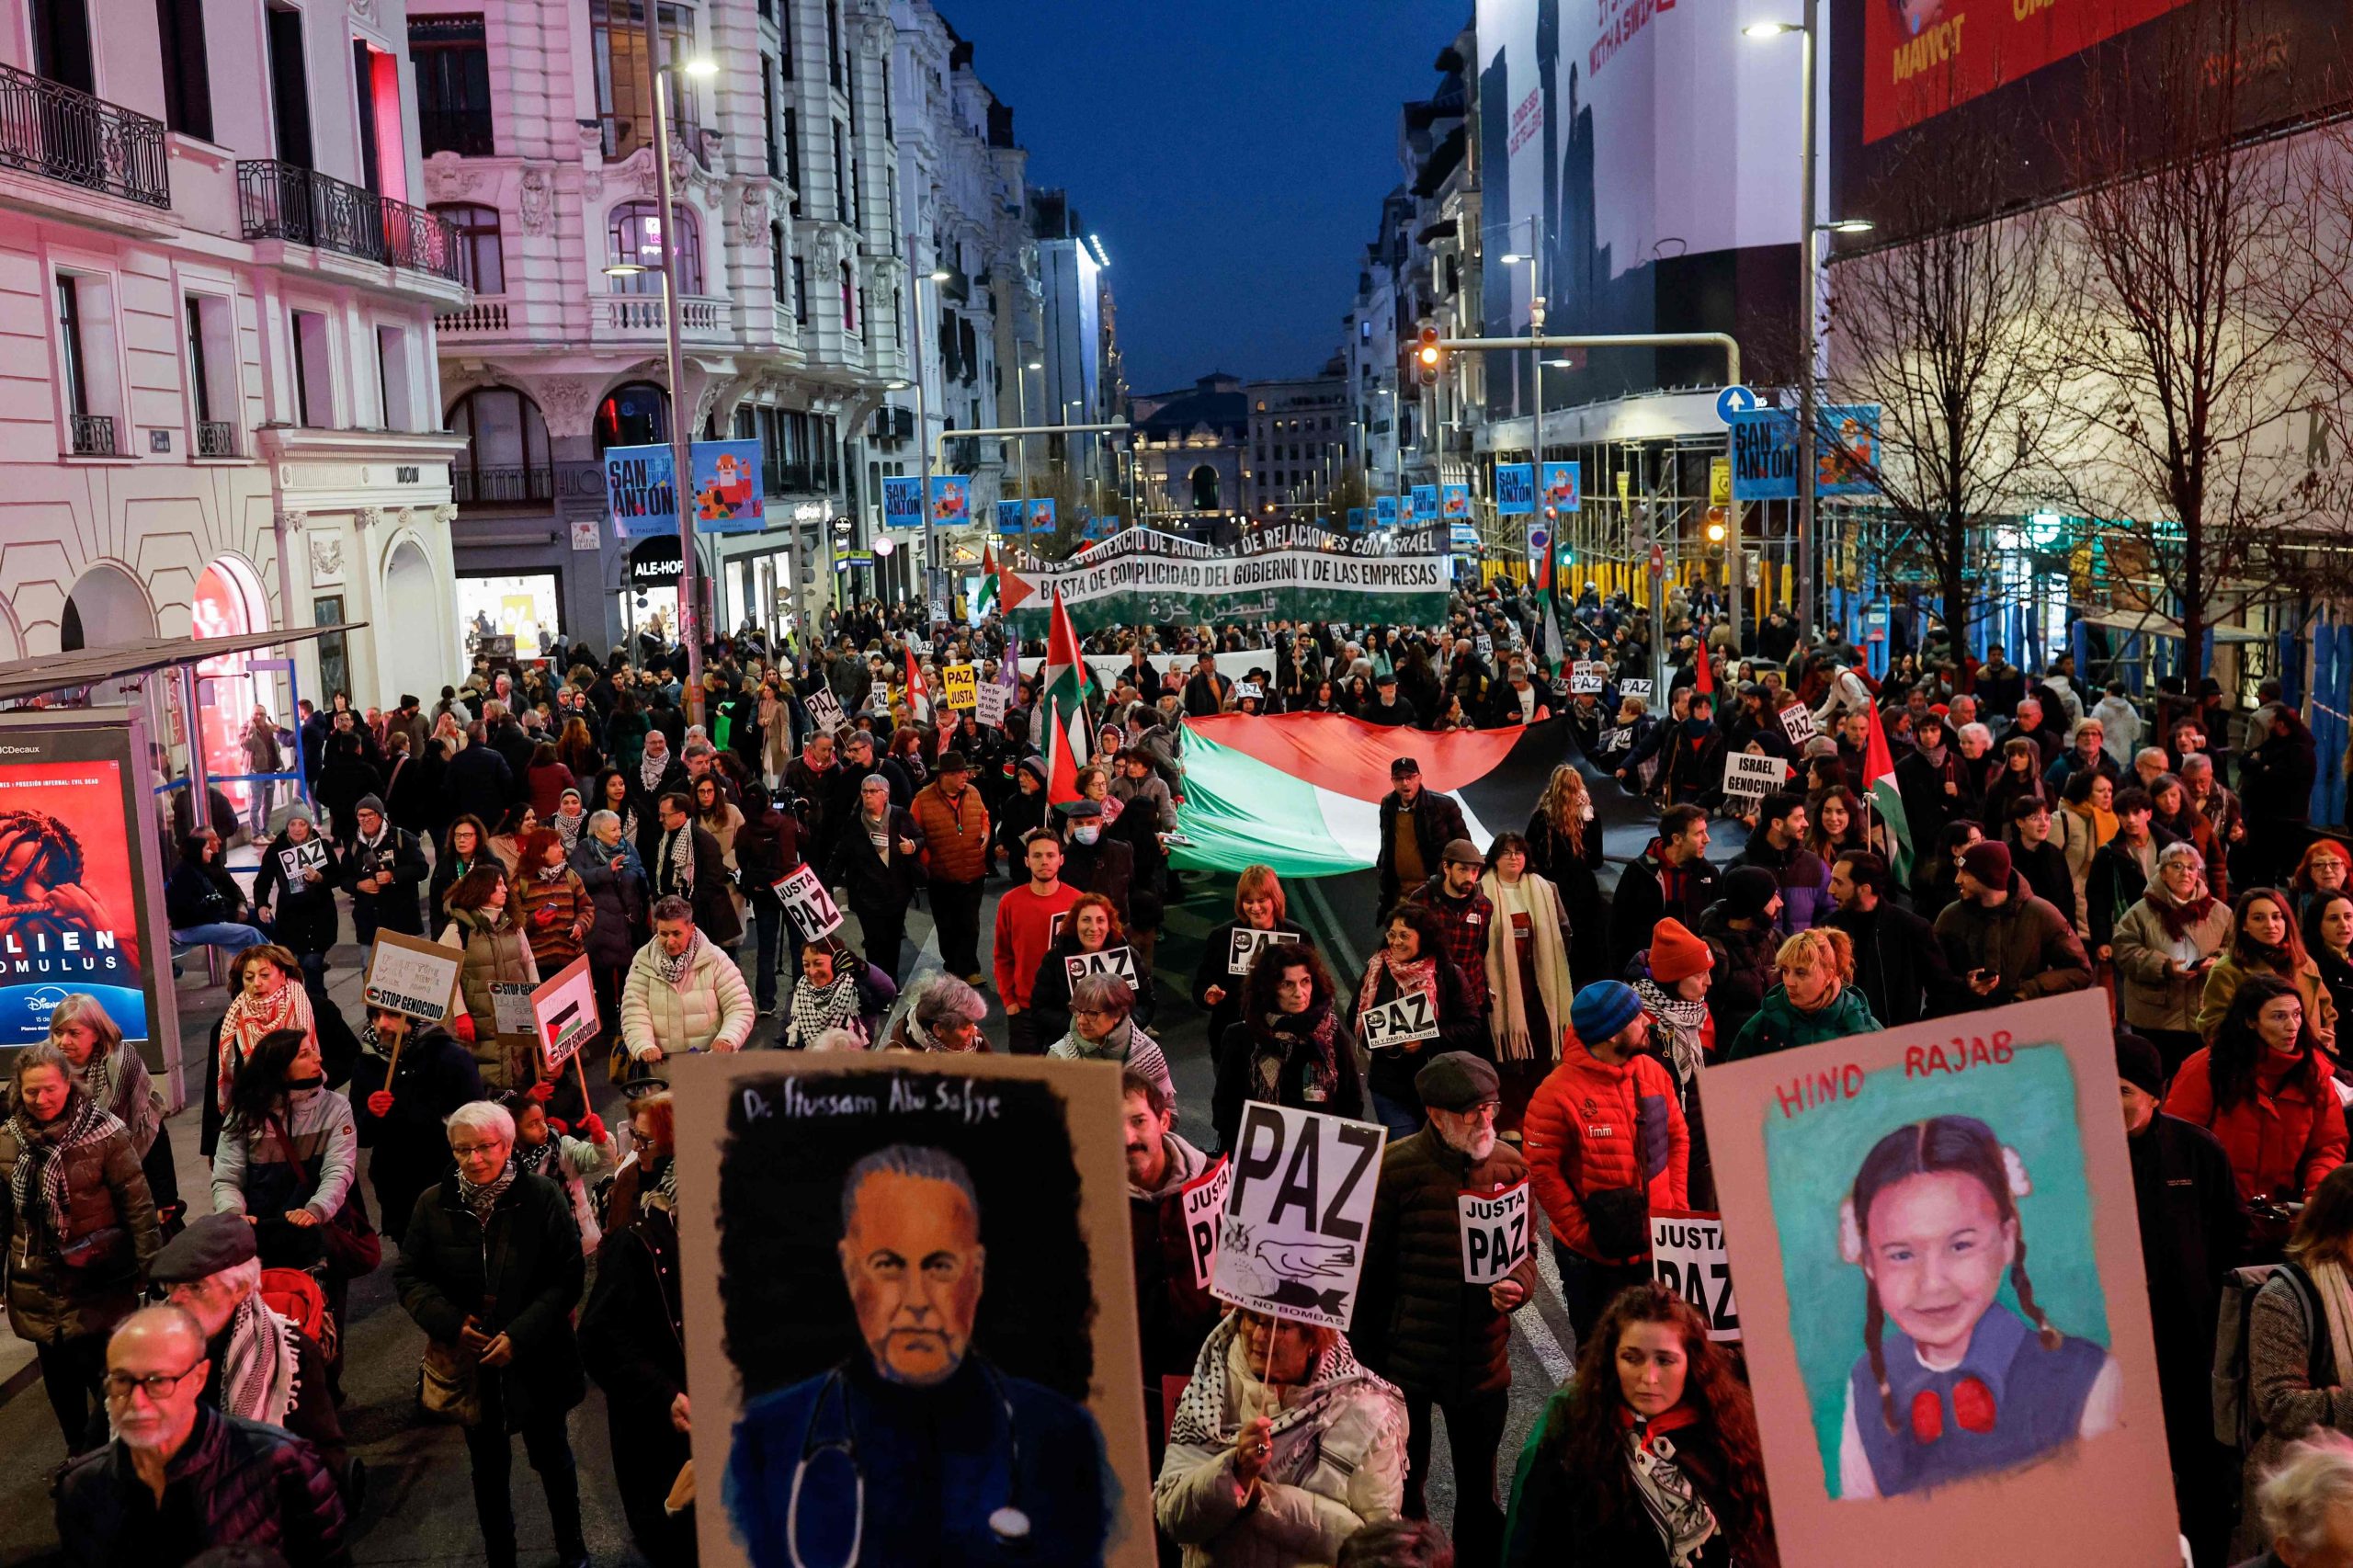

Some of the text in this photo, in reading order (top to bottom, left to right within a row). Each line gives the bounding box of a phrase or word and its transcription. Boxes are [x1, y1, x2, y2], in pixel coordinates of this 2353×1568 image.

[1736, 422, 1772, 452] SAN
[396, 466, 419, 484] WOW
[609, 460, 647, 489] SAN
[1736, 445, 1793, 480] ANTÓN
[885, 483, 906, 500] SAN
[1498, 472, 1519, 486] SAN
[613, 483, 675, 517] ANTÓN
[1017, 549, 1040, 572] FIN
[1044, 561, 1073, 574] DEL
[1075, 529, 1145, 566] COMERCIO
[1149, 533, 1168, 553] DE
[1171, 539, 1225, 559] ARMAS
[1229, 544, 1237, 557] Y
[1241, 532, 1263, 554] DE
[1263, 523, 1349, 551] RELACIONES
[1352, 538, 1382, 556] CON
[1386, 529, 1437, 553] ISRAEL
[634, 560, 683, 577] ALE-HOP
[1040, 557, 1438, 600] BASTA DE COMPLICIDAD DEL GOBIERNO Y DE LAS EMPRESAS
[931, 600, 943, 613] PAZ
[1200, 590, 1276, 622] فلسطين
[916, 642, 934, 654] PAZ
[1478, 642, 1492, 653] PAZ
[948, 670, 972, 685] PAZ
[1236, 682, 1261, 695] PAZ
[1572, 676, 1601, 689] PAZ
[1620, 679, 1652, 693] PAZ
[806, 690, 838, 718] PAZ
[873, 691, 888, 706] PAZ
[949, 689, 974, 705] JUSTA
[1783, 705, 1804, 721] JUSTA
[1786, 715, 1814, 741] PAZ
[1738, 757, 1776, 777] ISRAEL,
[279, 840, 326, 873] PAZ
[779, 872, 815, 901] JUSTA
[788, 887, 839, 938] PAZ
[6, 930, 115, 954] LIEN
[0, 955, 117, 974] OMULUS
[503, 983, 519, 995] STOP
[381, 989, 444, 1020] STOP GENOCIDIO
[1365, 993, 1436, 1040] PAZ
[557, 1018, 597, 1059] STOP GENOCIDIO
[1414, 1030, 1438, 1039] TIERRA
[1775, 1030, 2015, 1119] HIND RAJAB
[743, 1088, 774, 1123] Dr.
[888, 1076, 926, 1113] Abu
[1588, 1125, 1612, 1138] fmm
[1229, 1105, 1381, 1243] PAZ
[1189, 1172, 1228, 1214] JUSTA
[1466, 1190, 1525, 1221] JUSTA
[1467, 1211, 1526, 1277] PAZ
[1657, 1259, 1740, 1331] PAZ
[1253, 1300, 1274, 1311] NO
[1279, 1305, 1345, 1326] BOMBAS
